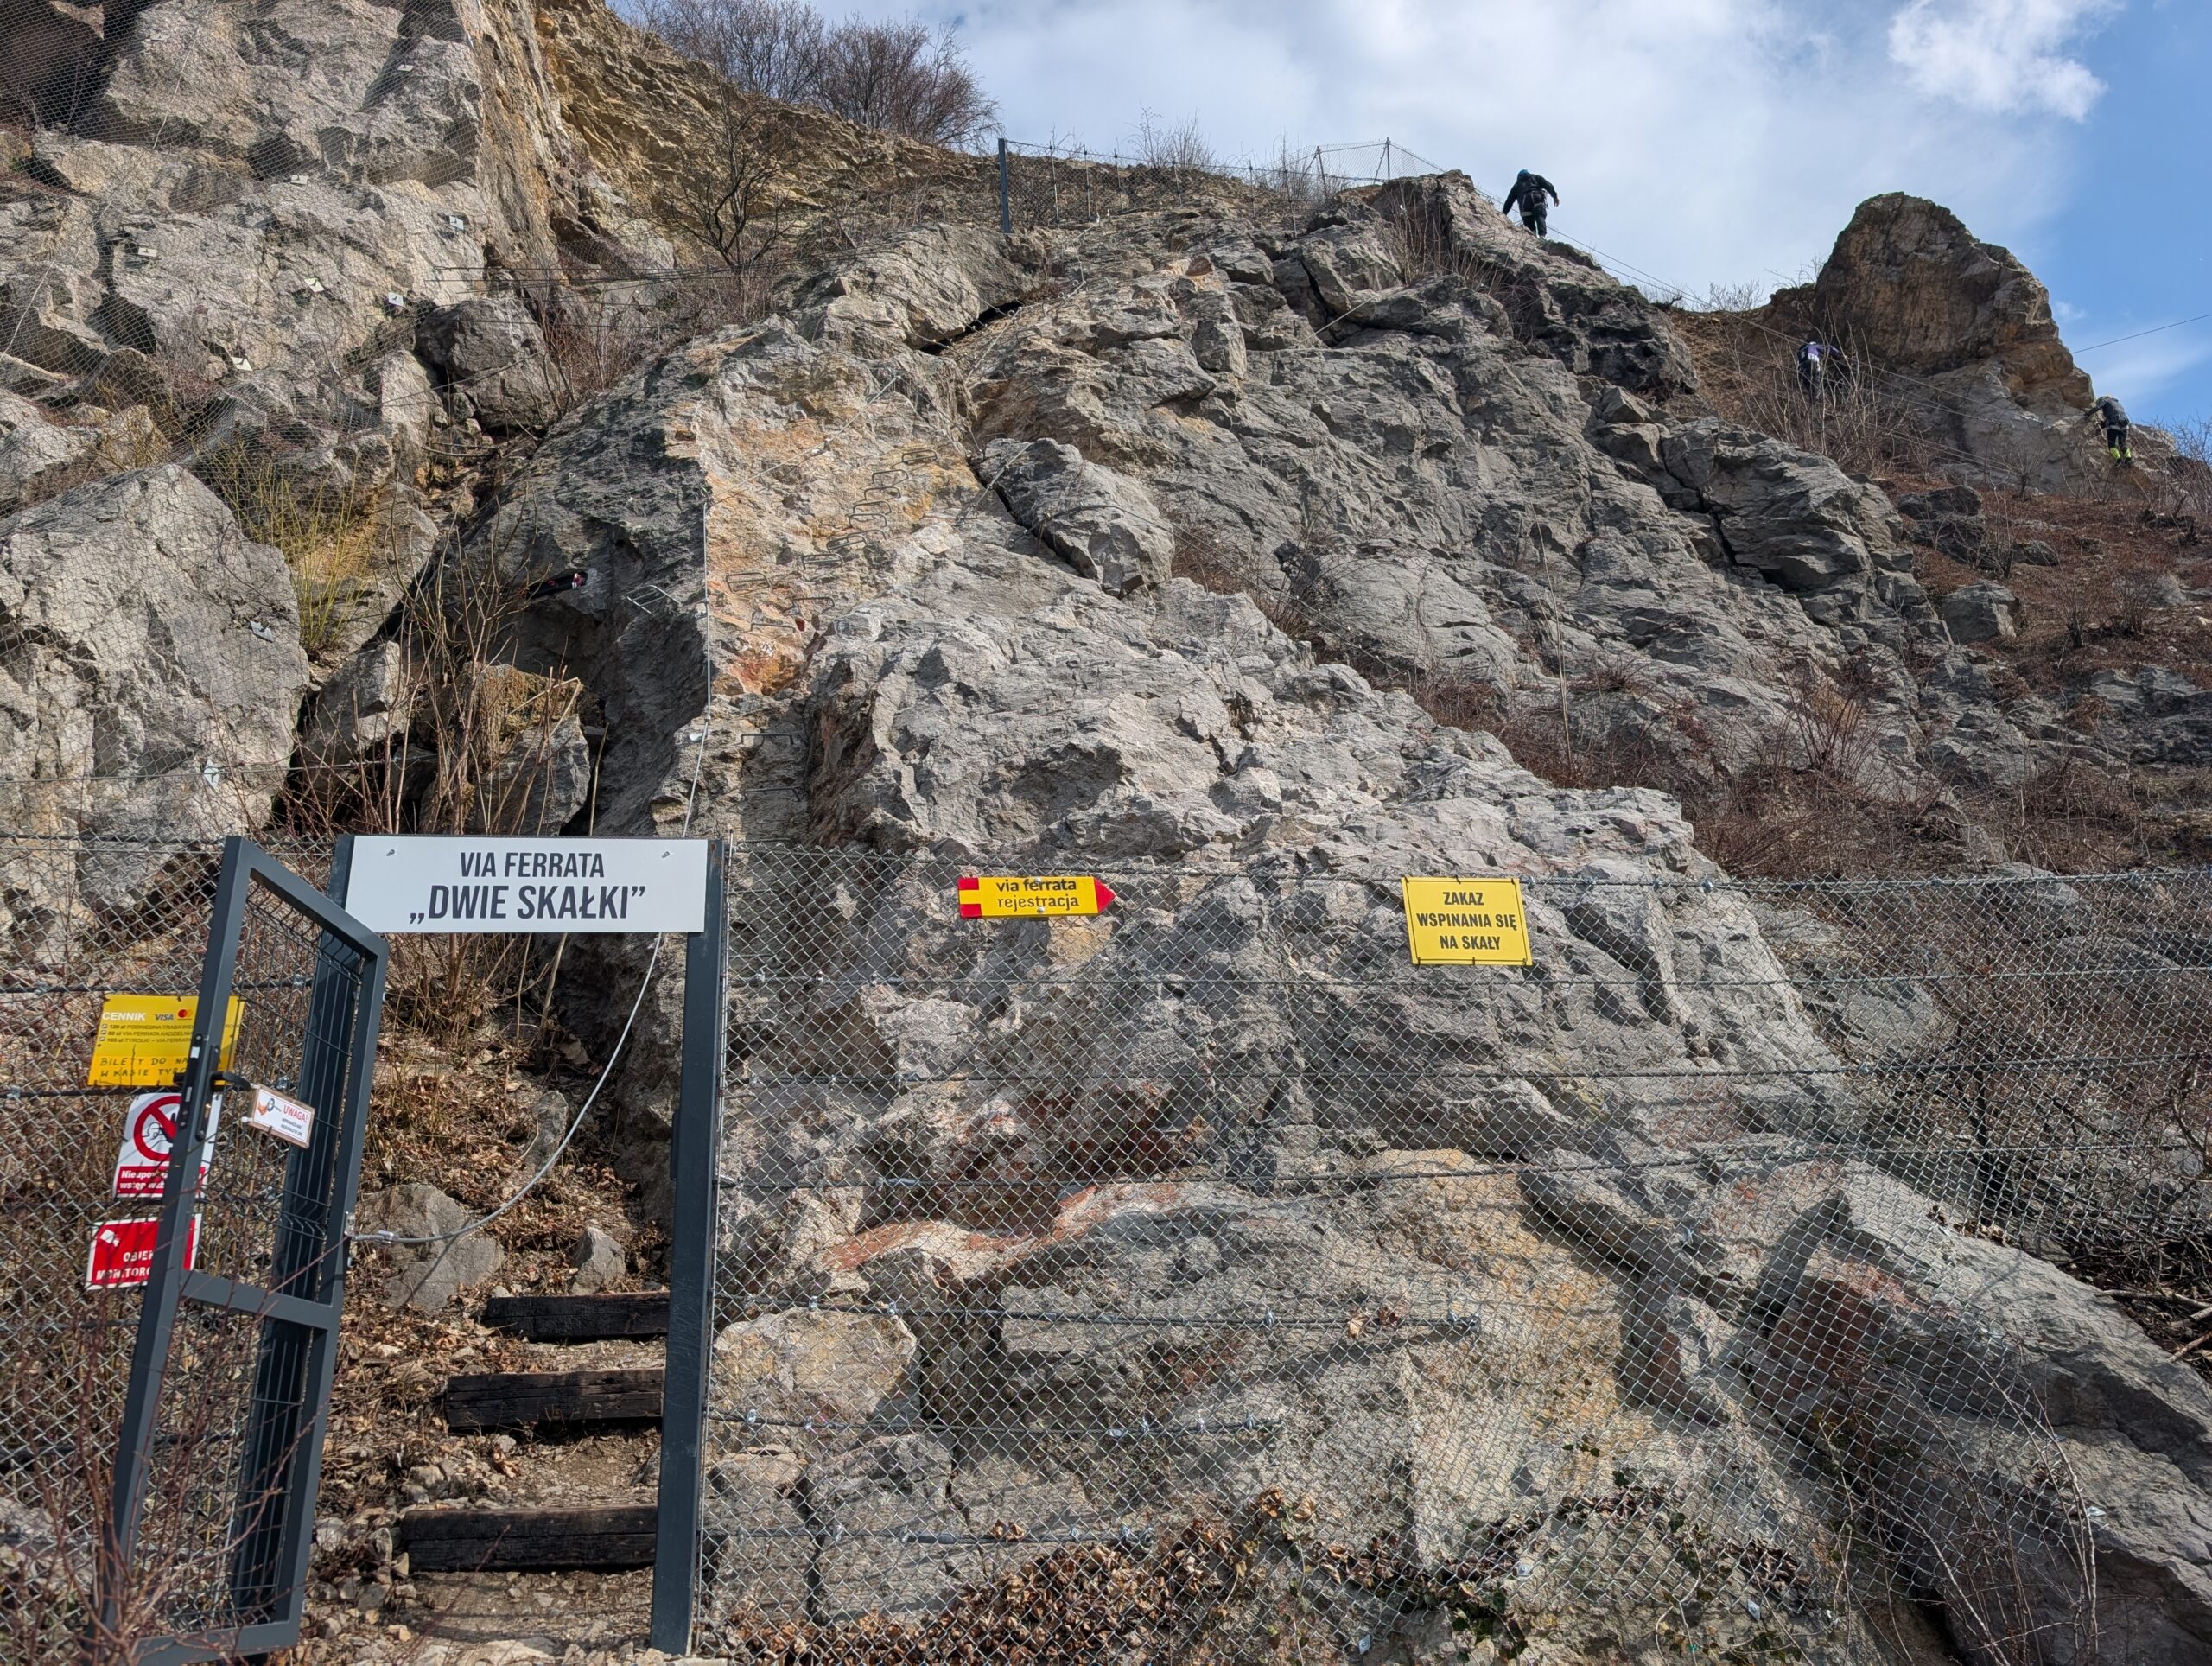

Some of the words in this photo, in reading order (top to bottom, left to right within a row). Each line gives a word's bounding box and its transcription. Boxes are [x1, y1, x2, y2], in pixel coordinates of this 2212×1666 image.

[461, 852, 497, 877] VIA
[504, 852, 605, 878] FERRATA
[995, 879, 1020, 893] via
[1023, 878, 1077, 892] ferrata
[409, 885, 508, 925] „DWIE
[517, 886, 646, 919] SKAŁKI”
[997, 894, 1079, 912] rejestracja
[1442, 892, 1484, 906] ZAKAZ
[1416, 912, 1492, 928] WSPINANIA
[1496, 914, 1517, 932] SIĘ
[1439, 935, 1459, 950] NA
[1462, 935, 1501, 951] SKAŁY
[102, 1012, 146, 1021] CENNIK
[99, 1057, 143, 1066] BILETY
[151, 1057, 167, 1065] DO
[113, 1068, 149, 1077] KASIE
[283, 1104, 308, 1123] UWAGA!
